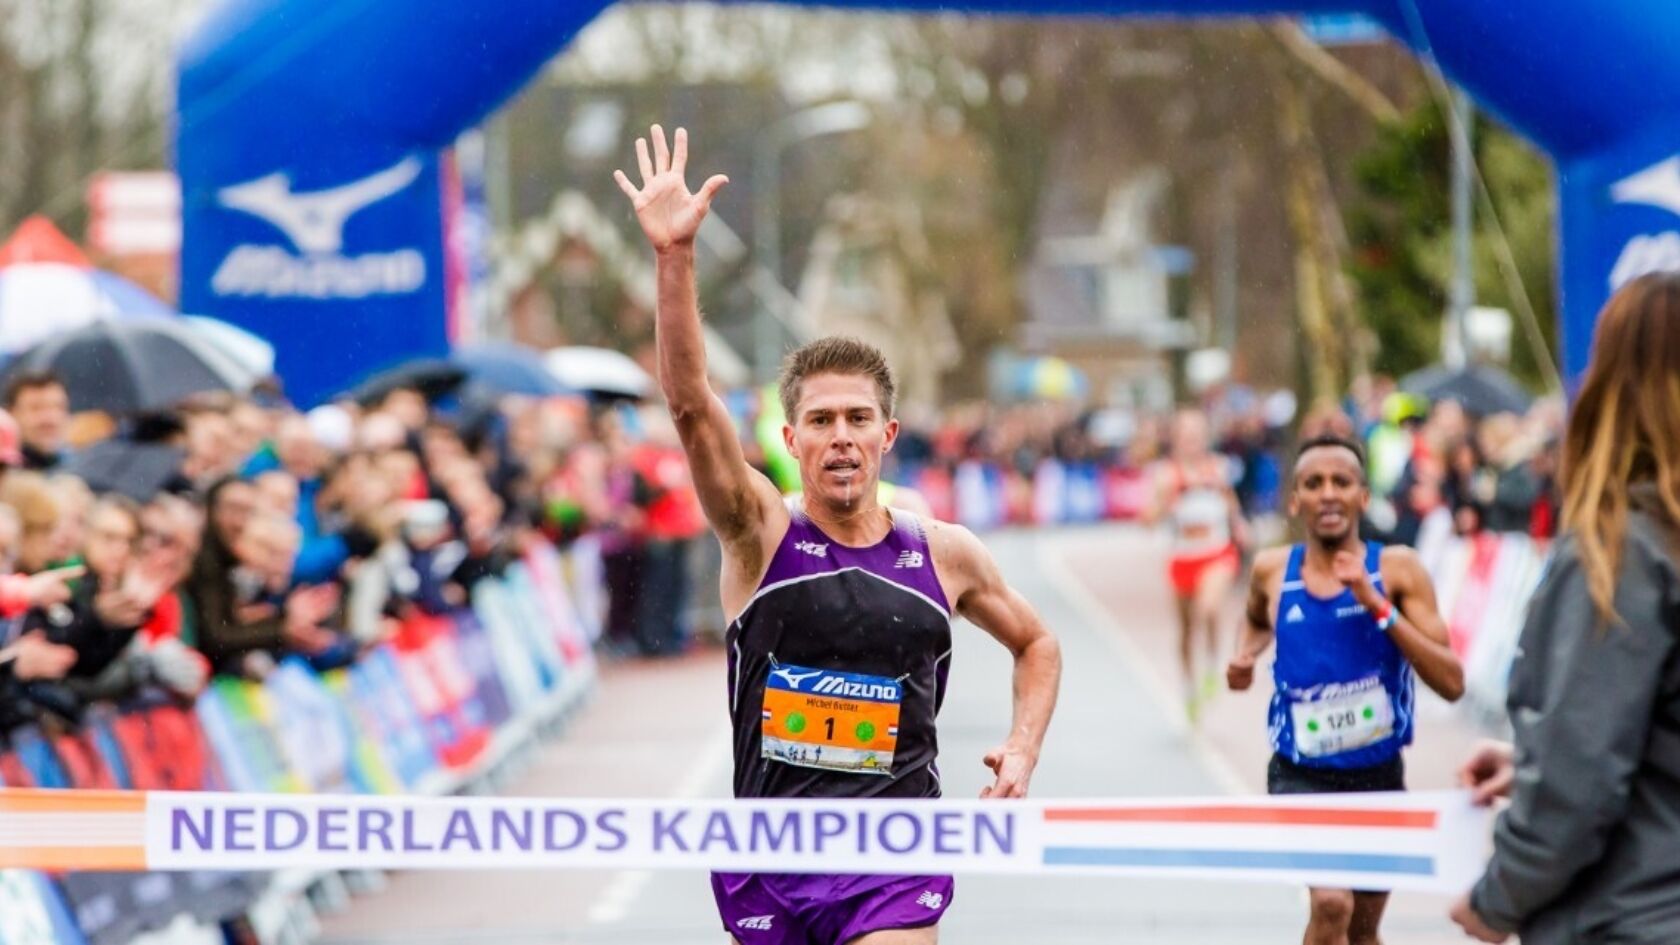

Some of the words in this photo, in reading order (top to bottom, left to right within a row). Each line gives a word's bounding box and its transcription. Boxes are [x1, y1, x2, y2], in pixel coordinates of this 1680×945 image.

[824, 717, 835, 740] 1
[1327, 710, 1356, 729] 120
[171, 806, 629, 853] NEDERLANDS
[651, 808, 1017, 855] KAMPIOEN
